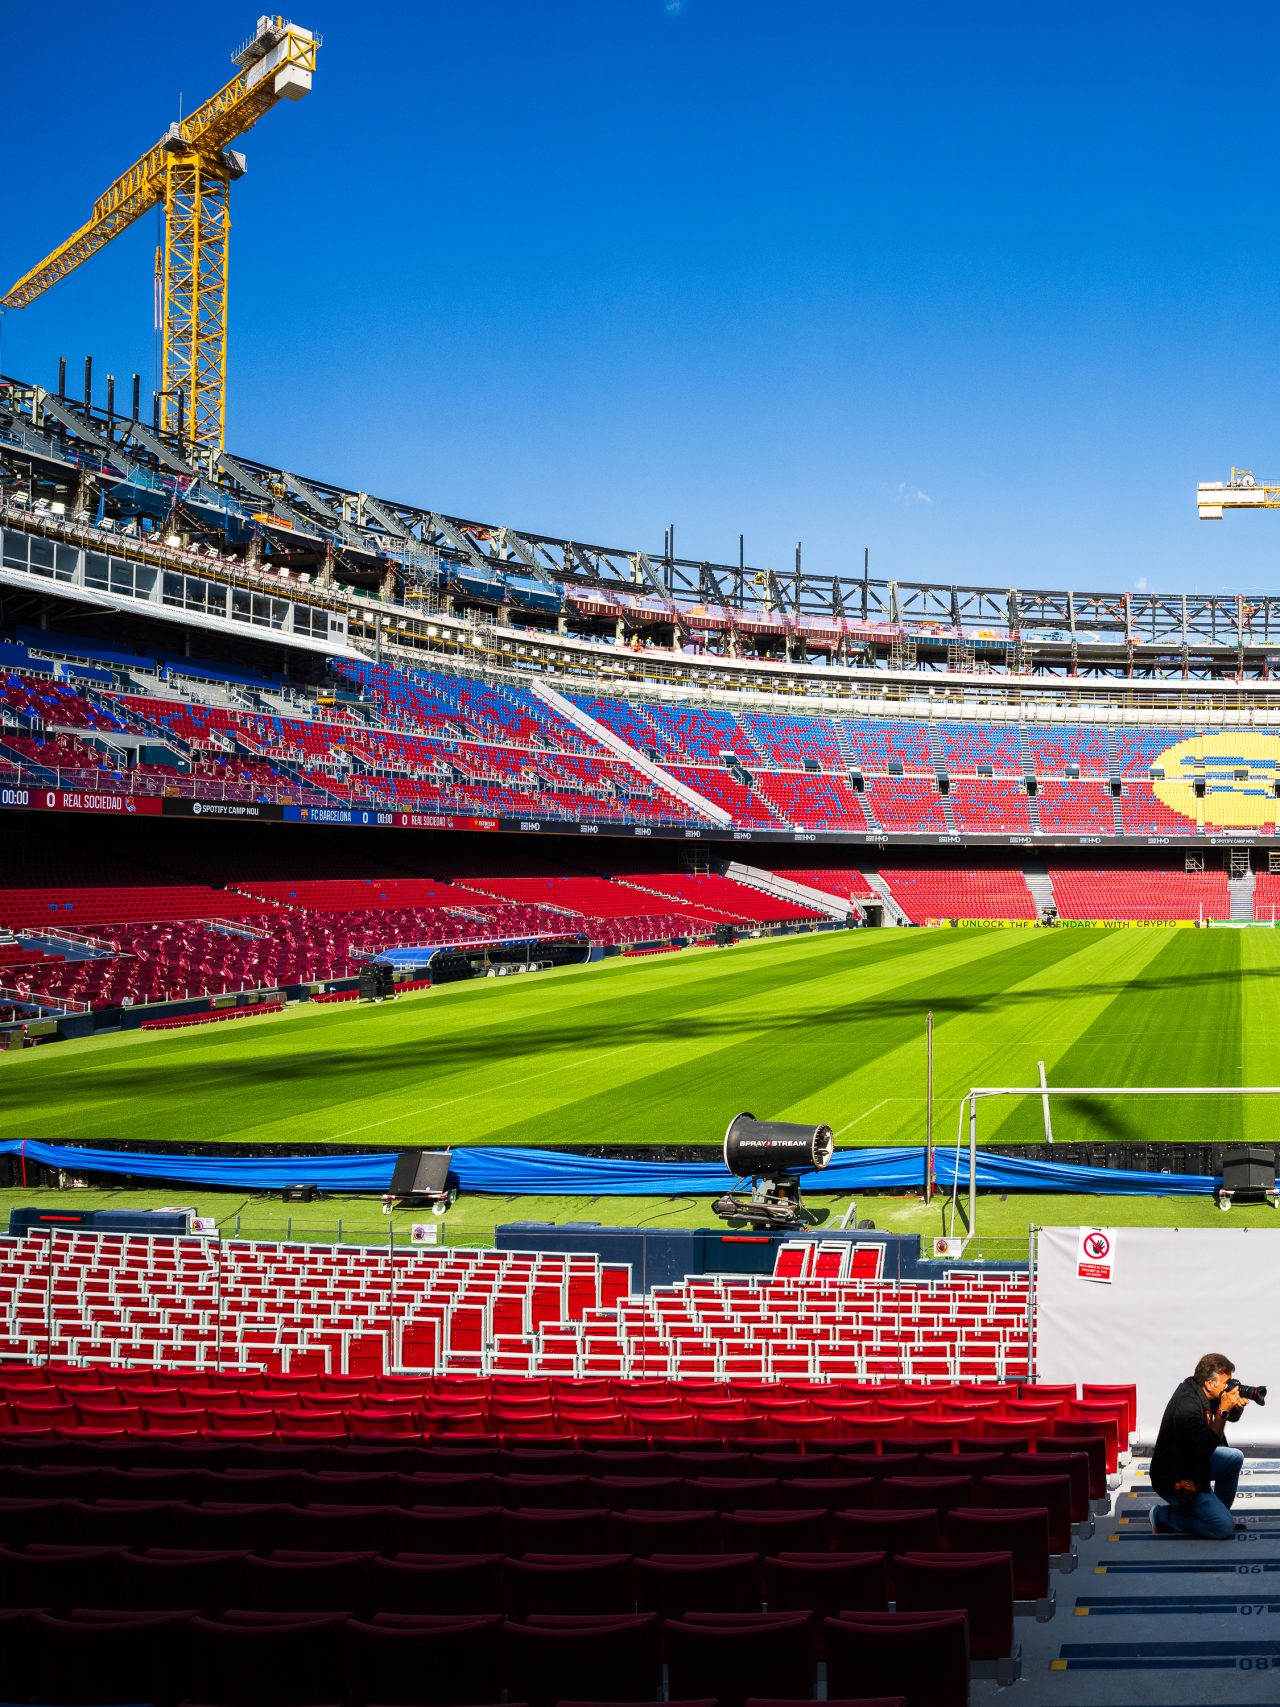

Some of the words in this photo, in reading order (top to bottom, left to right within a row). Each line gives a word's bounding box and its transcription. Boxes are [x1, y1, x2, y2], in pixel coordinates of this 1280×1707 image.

[2, 790, 28, 804] 00:00
[46, 792, 56, 807] 0
[64, 794, 82, 808] REAL
[84, 795, 122, 810] SOCIEDAD
[202, 804, 228, 814] SPOTIFY
[228, 806, 246, 814] CAMP
[246, 808, 259, 816] NOU
[311, 810, 318, 820] FC
[319, 810, 352, 822] BARCELONA
[362, 812, 368, 824] 0
[378, 813, 392, 824] 00:00
[402, 814, 408, 826] 0
[412, 815, 422, 826] REAL
[962, 920, 1004, 928] UNLOCK
[1137, 920, 1176, 928] CRYPTO
[1239, 1566, 1261, 1574] 06
[1240, 1605, 1264, 1615] 07
[1239, 1658, 1269, 1670] 08
